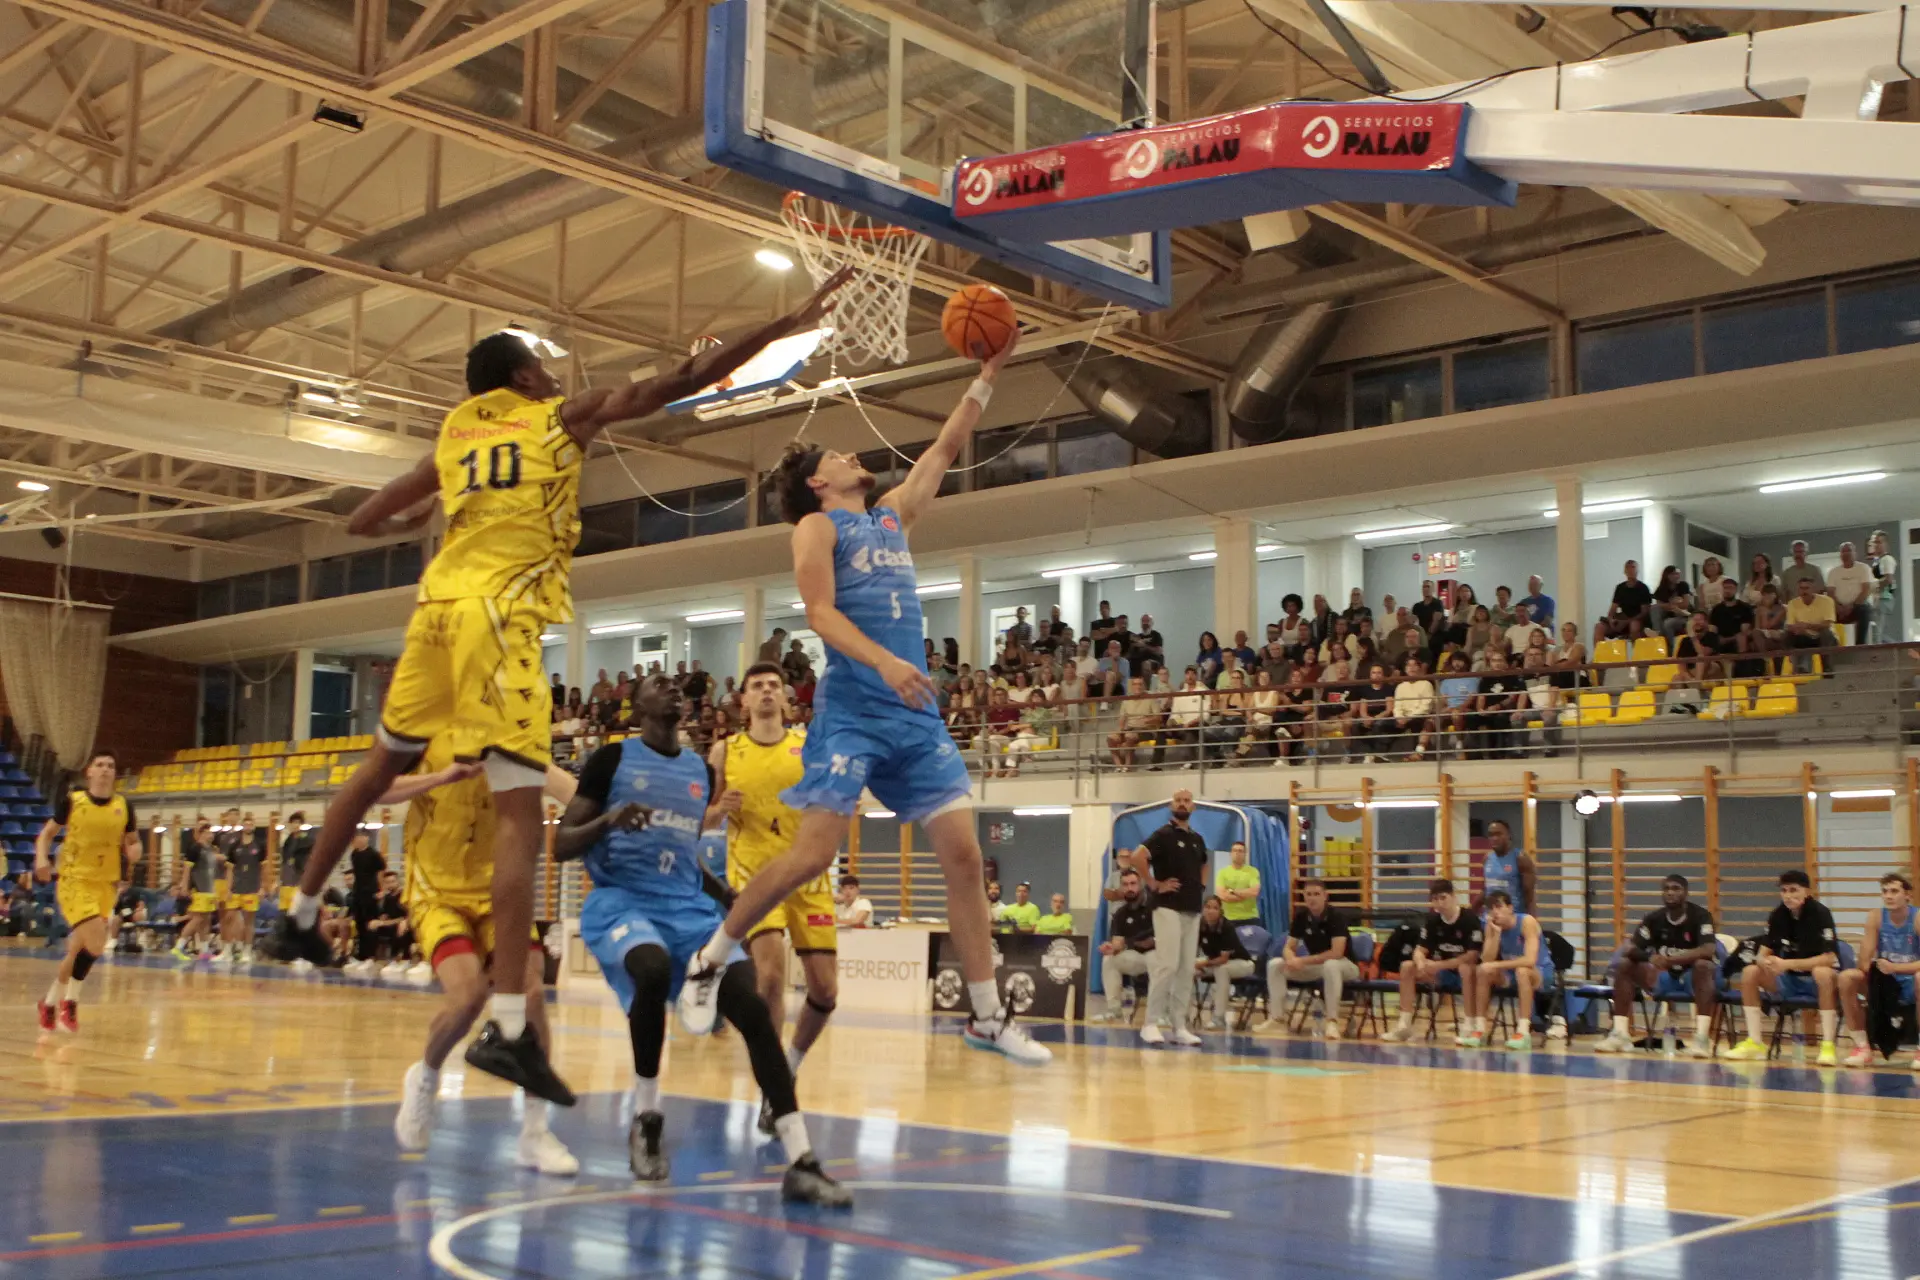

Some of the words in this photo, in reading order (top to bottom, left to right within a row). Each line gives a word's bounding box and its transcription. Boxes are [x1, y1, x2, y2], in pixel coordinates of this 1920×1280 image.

[1163, 124, 1241, 146] SERVICIOS
[1344, 116, 1433, 128] SERVICIOS
[1163, 138, 1240, 172] PALAU
[1342, 132, 1431, 156] PALAU
[456, 442, 521, 497] 10
[891, 591, 902, 619] 5
